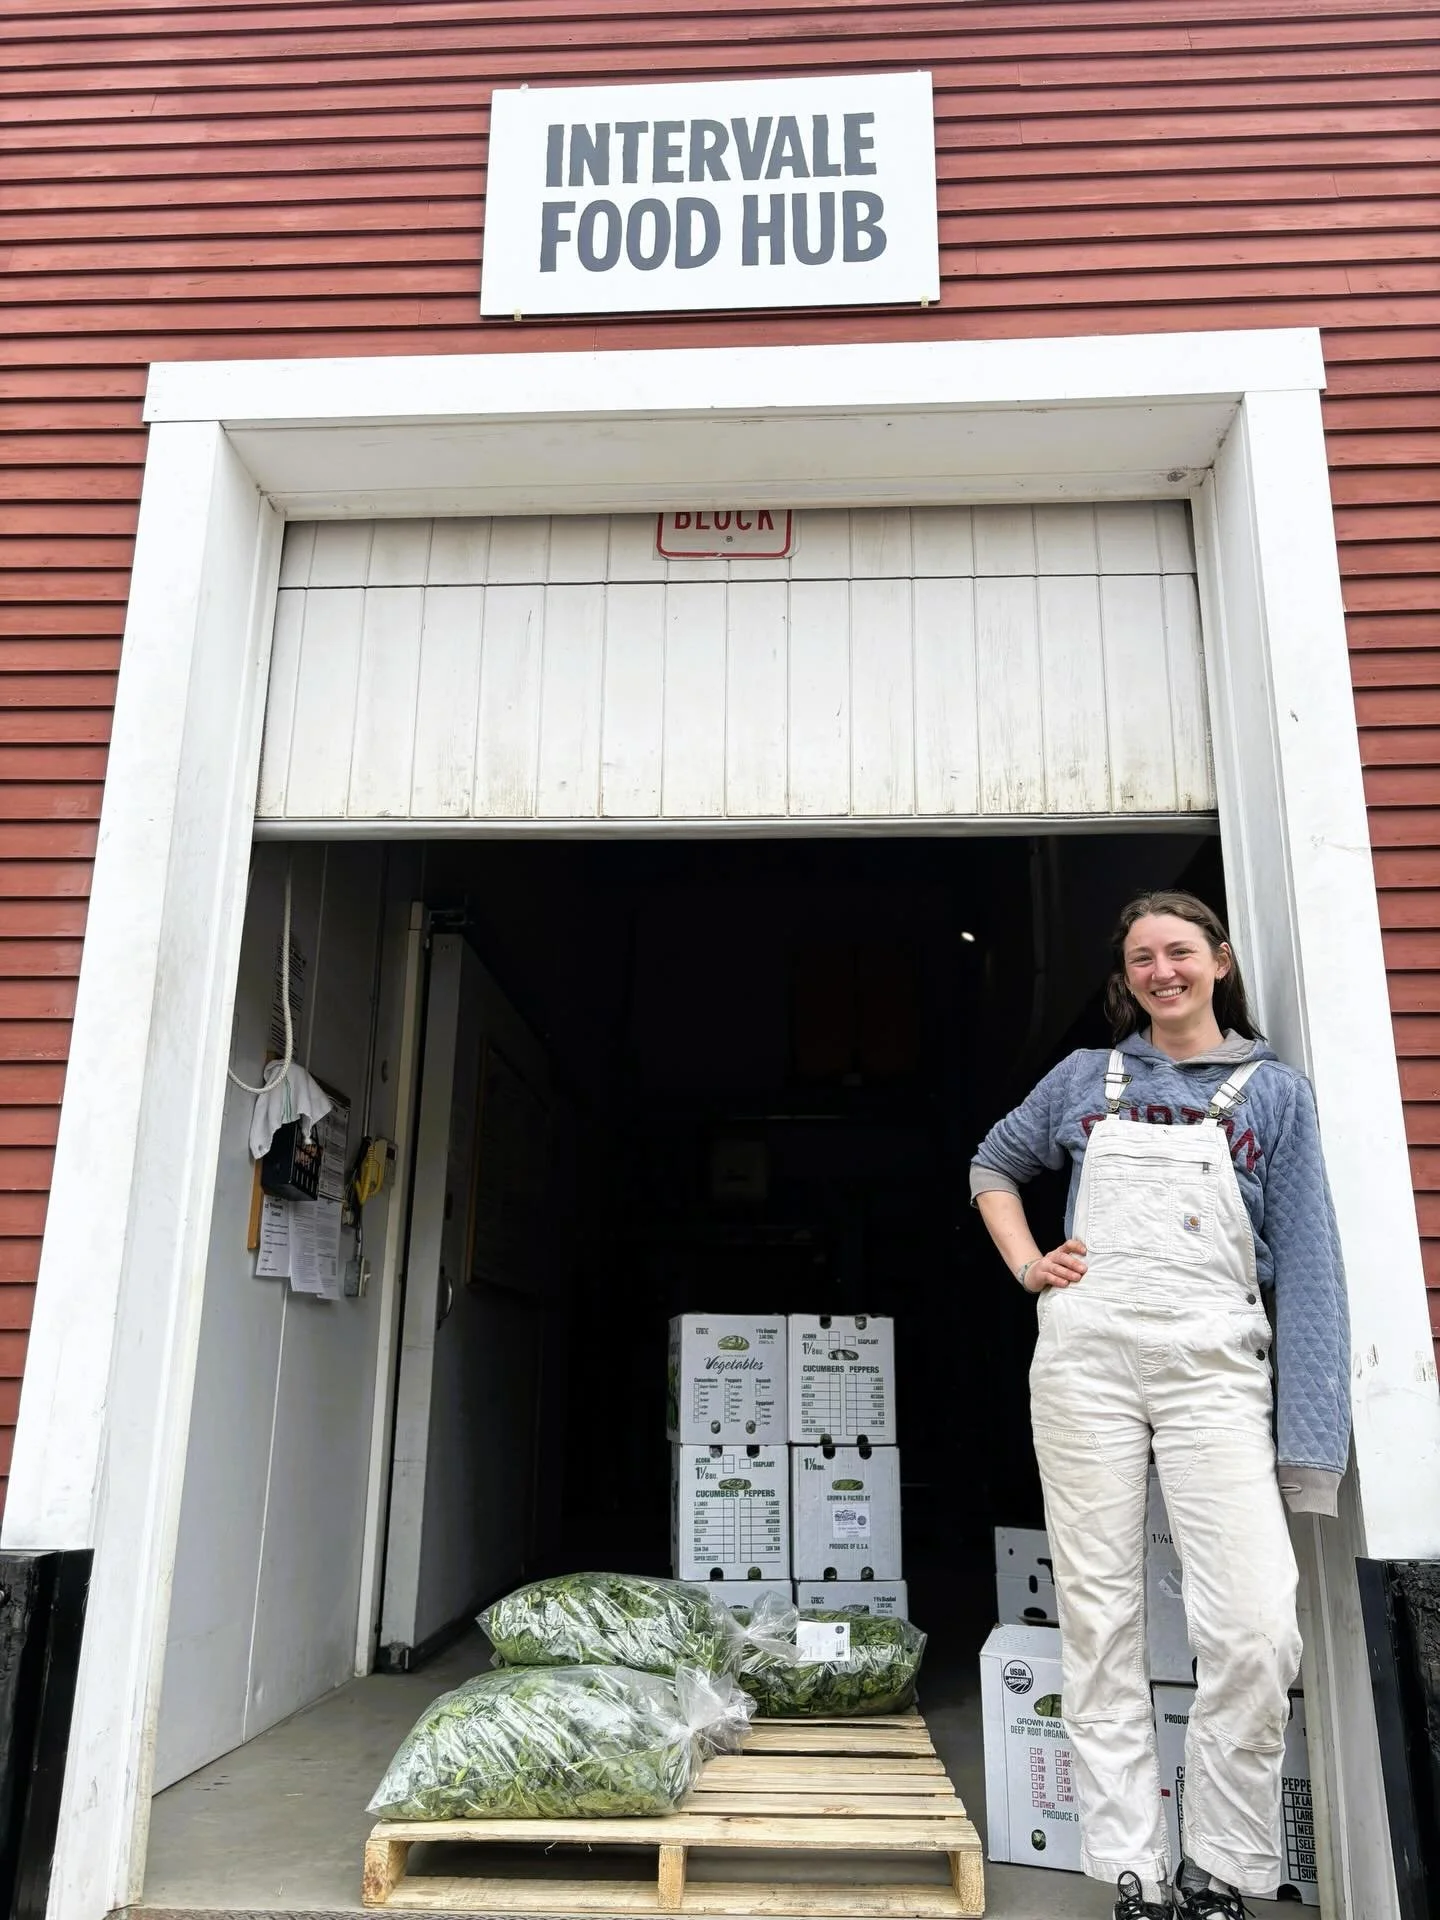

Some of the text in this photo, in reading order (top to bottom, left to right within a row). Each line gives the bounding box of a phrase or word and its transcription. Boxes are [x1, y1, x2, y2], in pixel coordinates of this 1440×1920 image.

[546, 112, 877, 187] INTERVALE
[540, 190, 887, 272] FOOD HUB
[704, 1355, 764, 1375] Vegetables
[803, 1365, 879, 1373] CUCUMBERS PEPPERS
[696, 1489, 775, 1498] CUCUMBERS PEPPERS
[1010, 1668, 1026, 1676] USDA
[1017, 1717, 1061, 1729] GROWN AND
[1010, 1725, 1025, 1735] DEEP
[1027, 1727, 1041, 1736] ROOT
[1042, 1809, 1073, 1821] PRODUCE
[1300, 1853, 1315, 1865] RED
